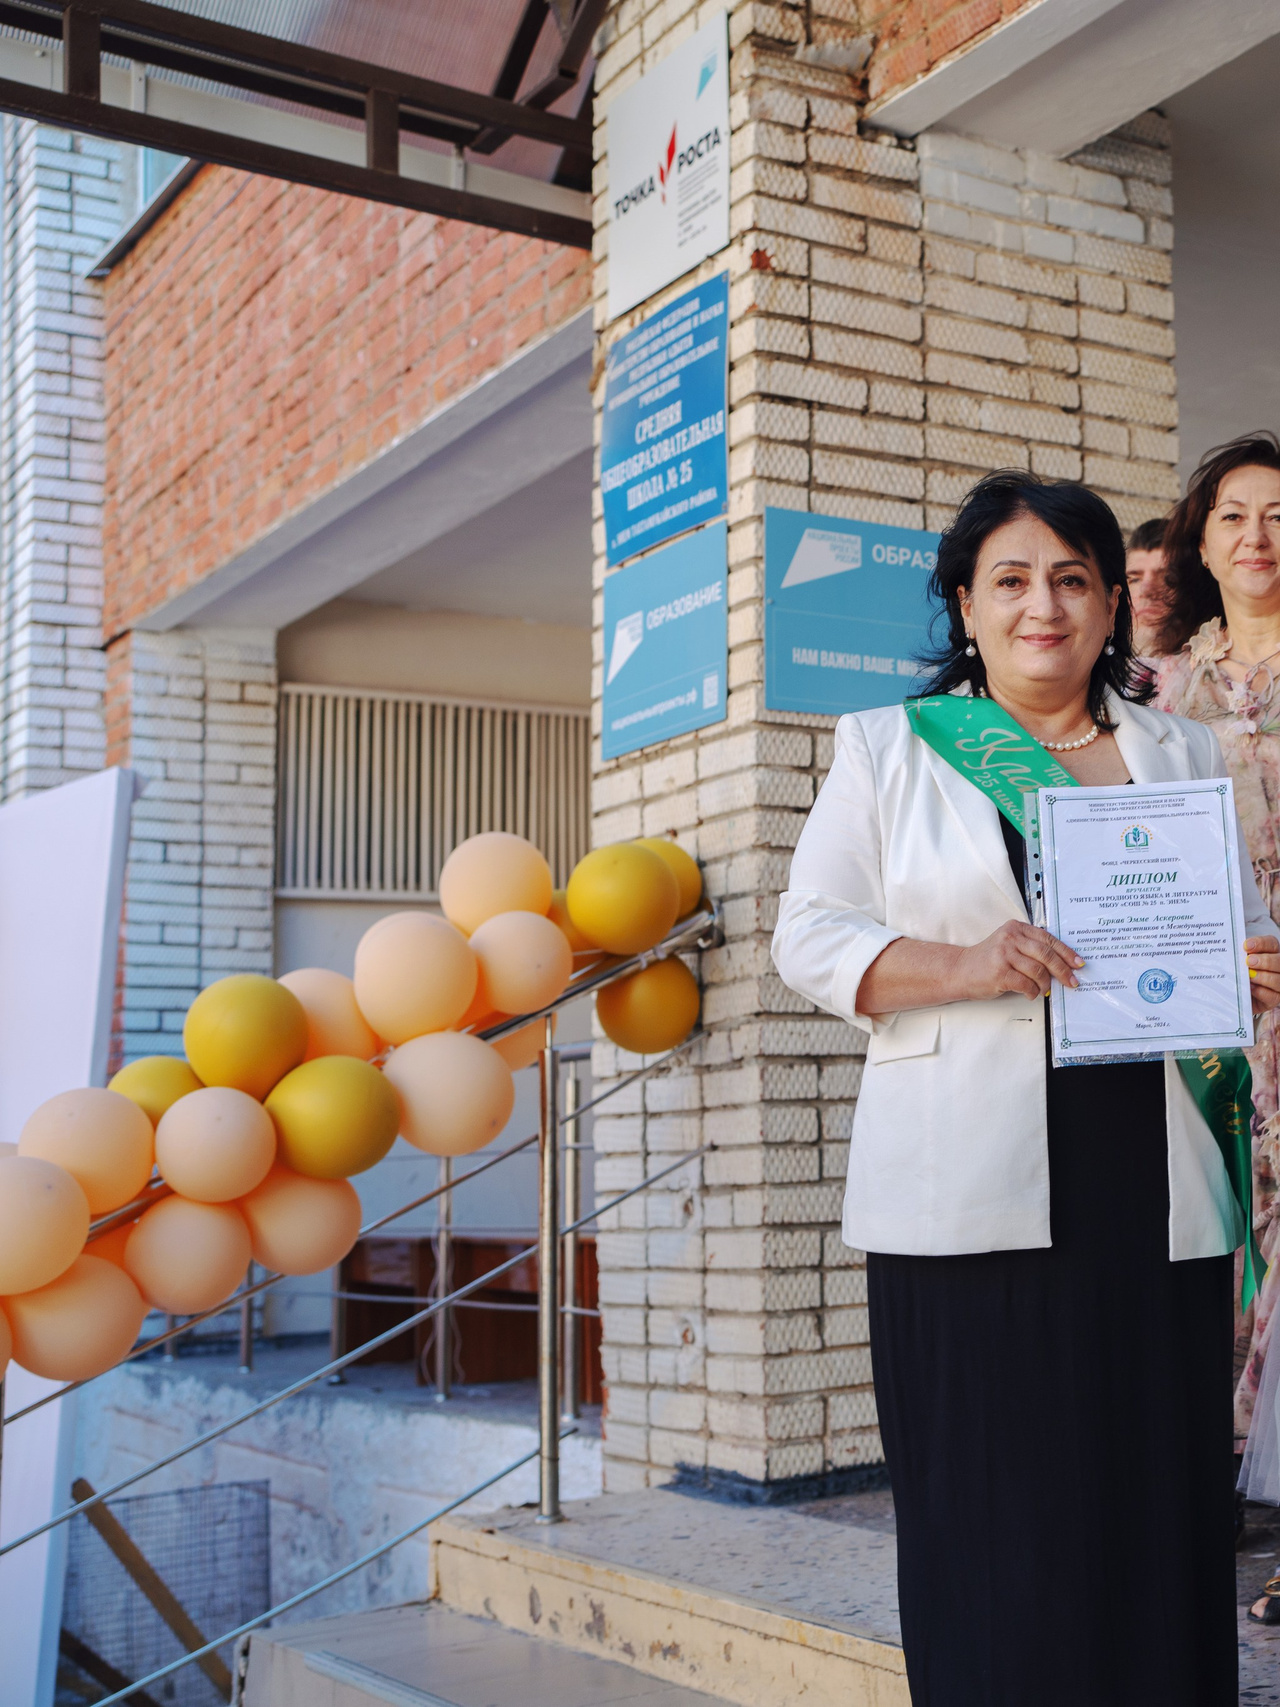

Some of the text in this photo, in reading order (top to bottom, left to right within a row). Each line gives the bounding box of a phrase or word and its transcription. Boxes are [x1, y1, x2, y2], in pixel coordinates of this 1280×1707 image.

[614, 173, 656, 220] ТОЧКА
[678, 126, 721, 174] РОСТА
[635, 399, 682, 445] СРЕДНЯЯ
[601, 408, 724, 494] ОБЩЕОБРАЗОВАТЕЛЬНАЯ
[627, 472, 664, 511] ШКОЛА
[680, 458, 693, 485] 25
[872, 543, 938, 571] ОБРАЗ
[646, 580, 722, 630] ОБРАЗОВАНИЕ
[792, 647, 818, 667] НАМ
[820, 650, 861, 671] ВАЖНО
[863, 654, 895, 676] ВАШЕ
[973, 771, 999, 789] 25
[1106, 871, 1178, 888] ДИПЛОМ
[1171, 890, 1218, 898] ЛИТЕРАТУРЫ
[1076, 927, 1116, 935] подготовку
[1118, 925, 1159, 933] участников
[1166, 922, 1224, 930] Международном
[1097, 914, 1194, 926] Туркав Эмме Аскеровне
[1077, 936, 1108, 944] конкурсе
[1169, 931, 1195, 939] родном
[1183, 947, 1208, 956] родной
